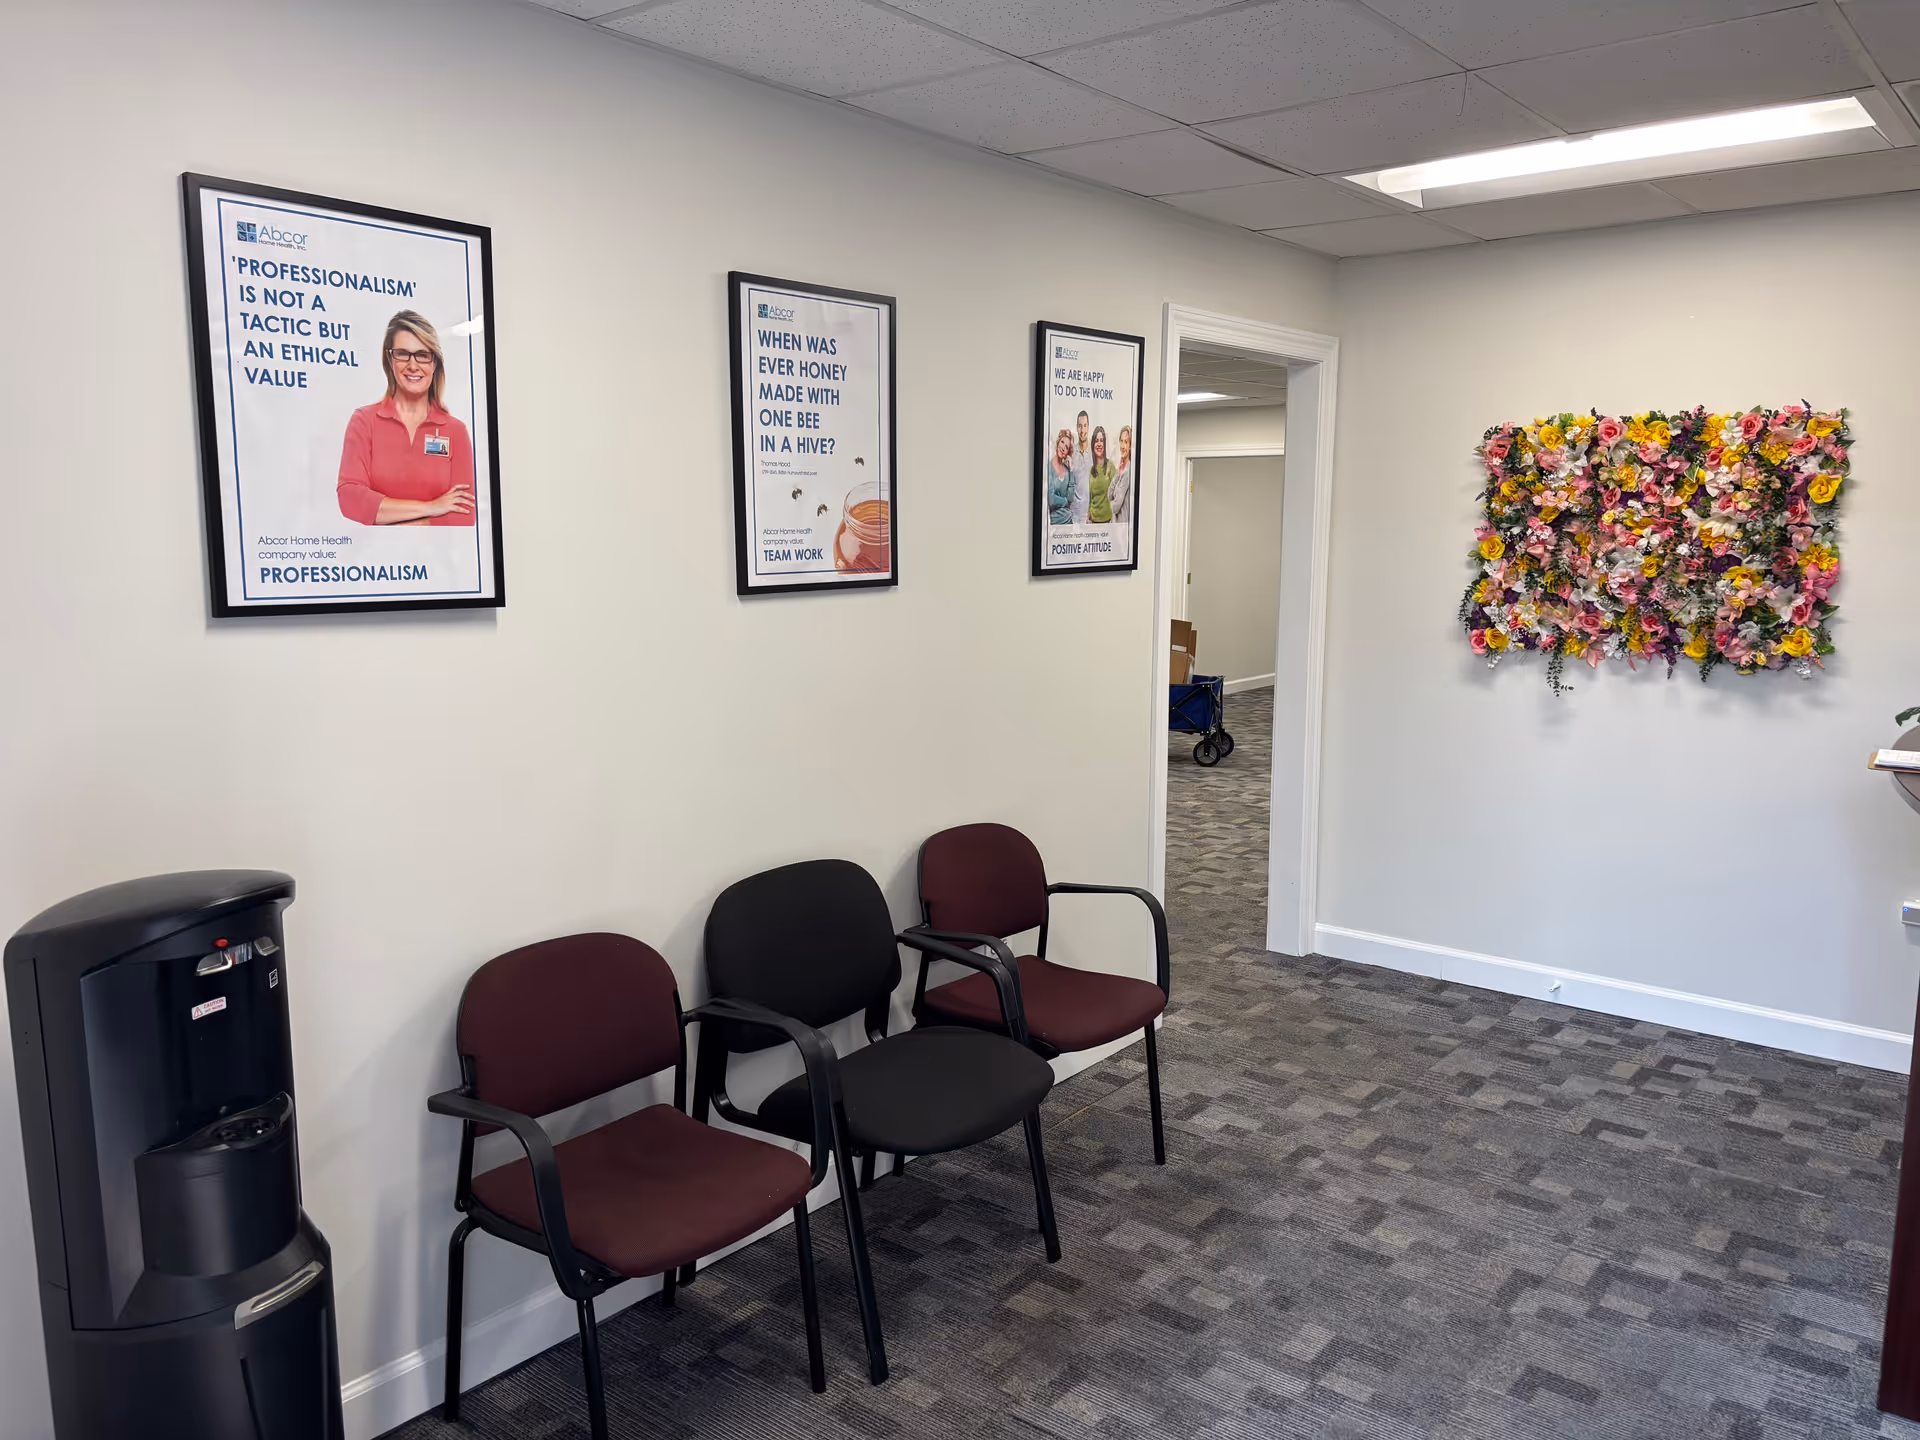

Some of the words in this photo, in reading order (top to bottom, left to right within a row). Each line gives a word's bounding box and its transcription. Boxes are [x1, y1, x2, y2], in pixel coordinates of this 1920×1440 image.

[259, 225, 308, 245] Abcor
[276, 242, 296, 250] Health,
[232, 255, 417, 298] 'PROFESSIONALISM'
[239, 285, 256, 304] IS
[263, 287, 305, 309] NOT
[311, 294, 326, 312] A
[769, 305, 795, 319] Abcor
[239, 312, 312, 337] TACTIC
[319, 321, 351, 341] BUT
[758, 329, 801, 351] WHEN
[806, 335, 837, 355] WAS
[243, 340, 274, 360] AN
[281, 343, 359, 368] ETHICAL
[243, 366, 308, 389] VALUE
[759, 356, 794, 377] EVER
[799, 360, 847, 381] HONEY
[1055, 367, 1066, 380] WE
[1067, 368, 1082, 381] ARE
[1083, 370, 1105, 383] HAPPY
[759, 382, 803, 403] MADE
[807, 386, 840, 406] WITH
[1054, 384, 1064, 396] TO
[1065, 385, 1077, 397] DO
[1079, 386, 1091, 398] THE
[1092, 387, 1114, 400] WORK
[759, 409, 793, 428] ONE
[797, 411, 820, 429] BEE
[760, 434, 776, 453] IN
[780, 435, 792, 453] A
[797, 436, 836, 455] HIVE?
[258, 535, 288, 546] Abcor
[290, 535, 320, 546] Home
[321, 535, 353, 546] Health
[1052, 543, 1082, 555] POSITIVE
[1083, 541, 1112, 553] ATTITUDE
[258, 549, 306, 561] company
[308, 549, 337, 559] value:
[763, 549, 792, 562] TEAM
[794, 548, 824, 561] WORK
[260, 564, 428, 584] PROFESSIONALISM
[204, 999, 224, 1008] CAUTION
